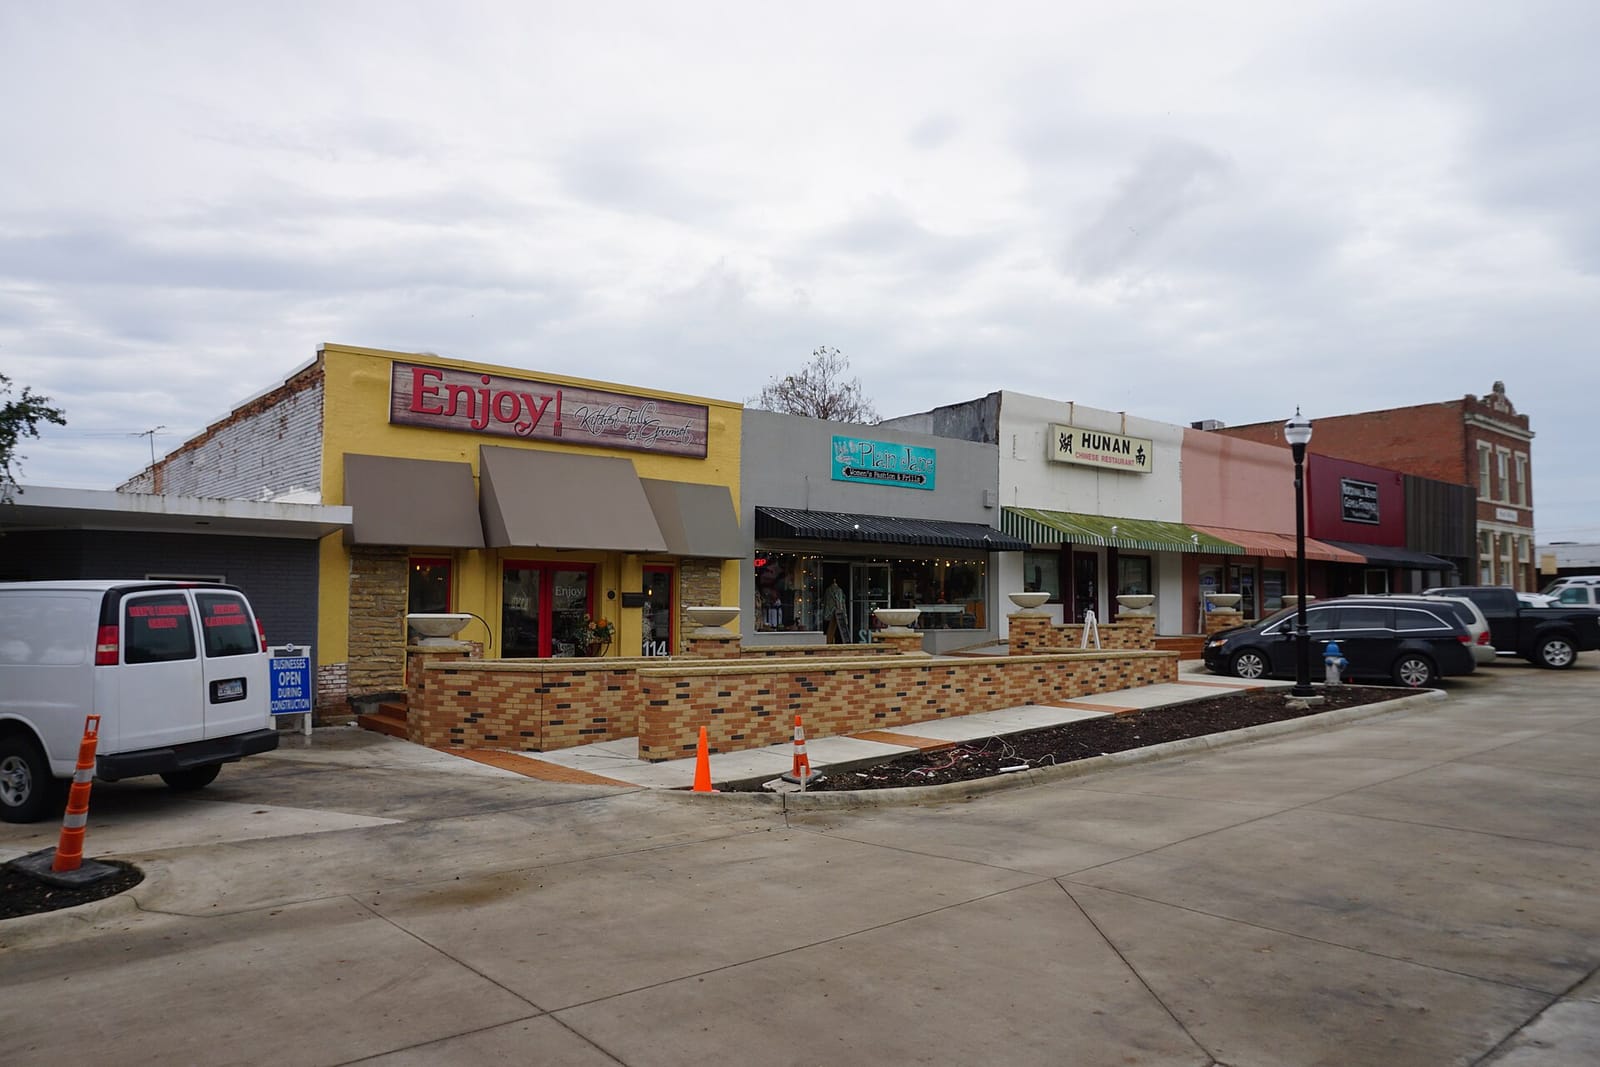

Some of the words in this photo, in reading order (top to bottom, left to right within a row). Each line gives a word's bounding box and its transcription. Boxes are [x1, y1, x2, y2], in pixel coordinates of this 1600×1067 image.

[408, 367, 563, 437] Enjoy!
[574, 404, 619, 435] Kitchen
[640, 419, 692, 448] Gourmet
[1081, 433, 1131, 455] HUNAN
[858, 441, 896, 468] Plain
[902, 447, 934, 473] Jane
[1075, 452, 1099, 461] CHINESE
[1101, 456, 1134, 465] RESTAURANT
[850, 469, 872, 477] Women's
[642, 640, 667, 657] 114
[273, 659, 306, 670] BUSINESSES
[278, 671, 301, 686] OPEN
[277, 687, 302, 698] DURING
[271, 699, 309, 711] CONSTRUCTION
